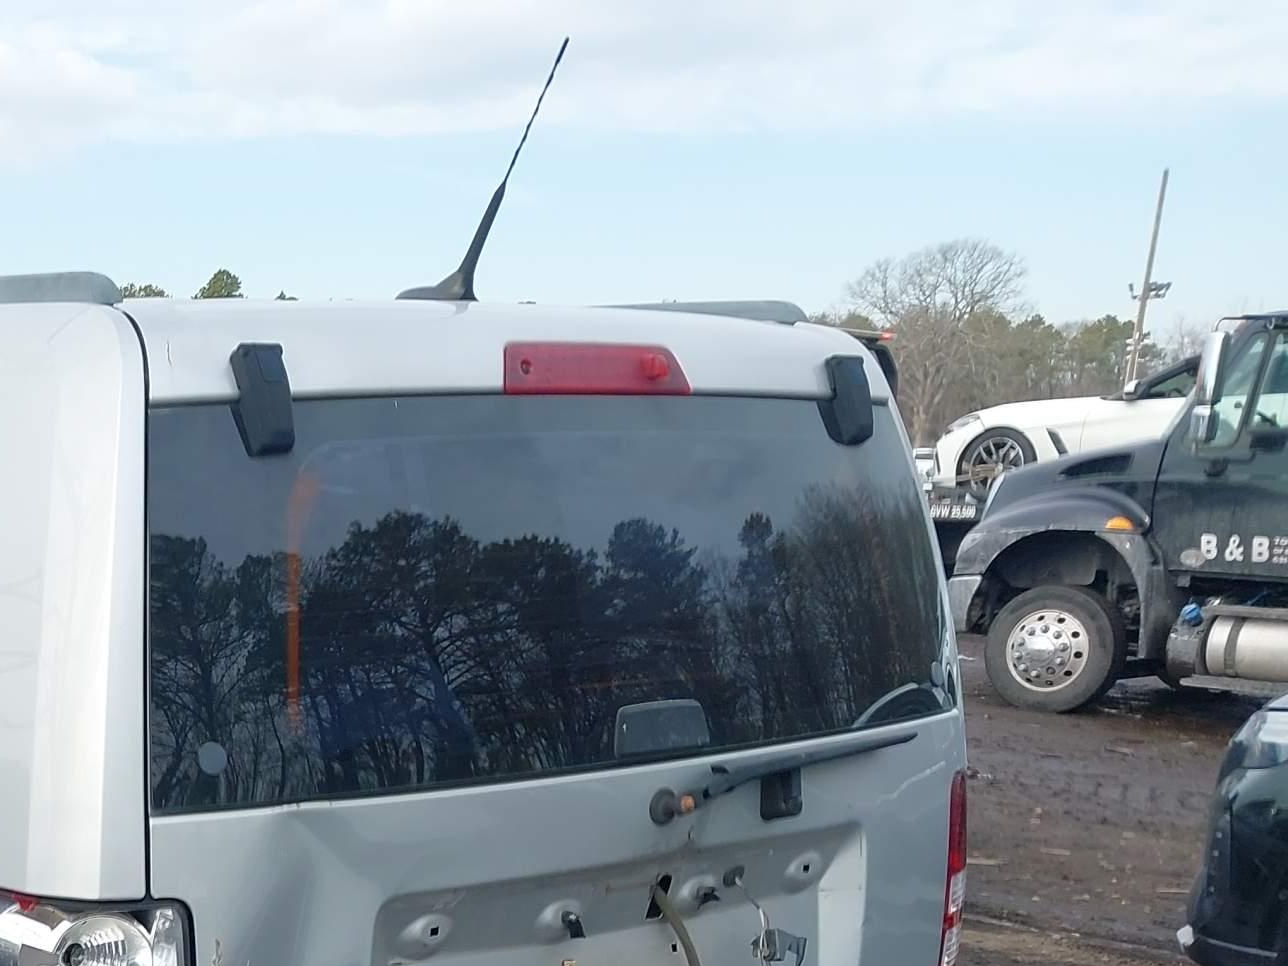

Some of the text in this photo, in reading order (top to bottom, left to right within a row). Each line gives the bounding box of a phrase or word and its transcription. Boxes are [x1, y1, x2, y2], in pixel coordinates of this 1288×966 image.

[930, 504, 951, 518] GVW
[1201, 533, 1270, 563] B & B
